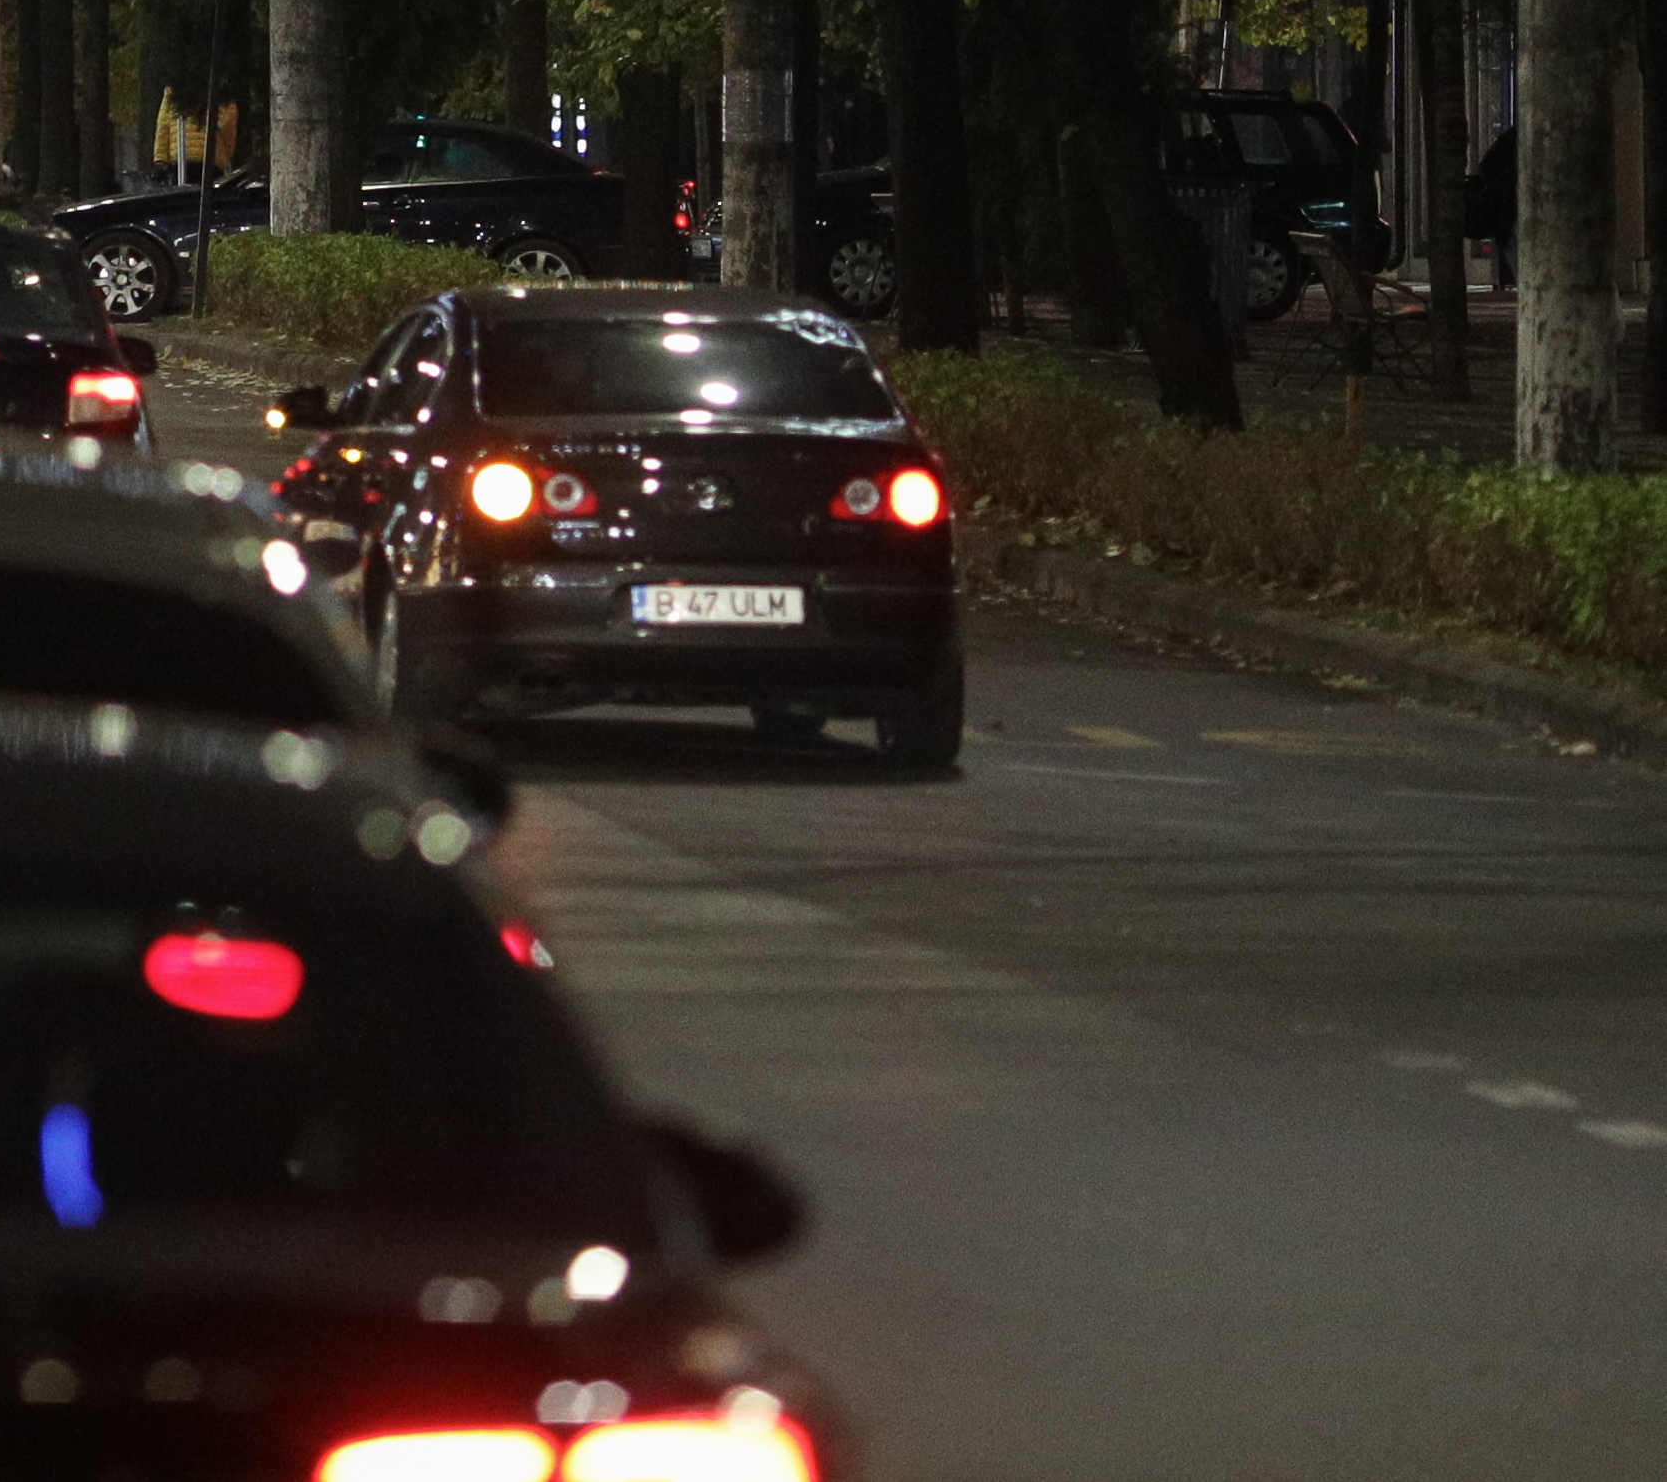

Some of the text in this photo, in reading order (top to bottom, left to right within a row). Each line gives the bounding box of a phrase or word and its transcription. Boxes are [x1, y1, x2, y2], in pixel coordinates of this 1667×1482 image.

[655, 590, 787, 617] B 47 ULM
